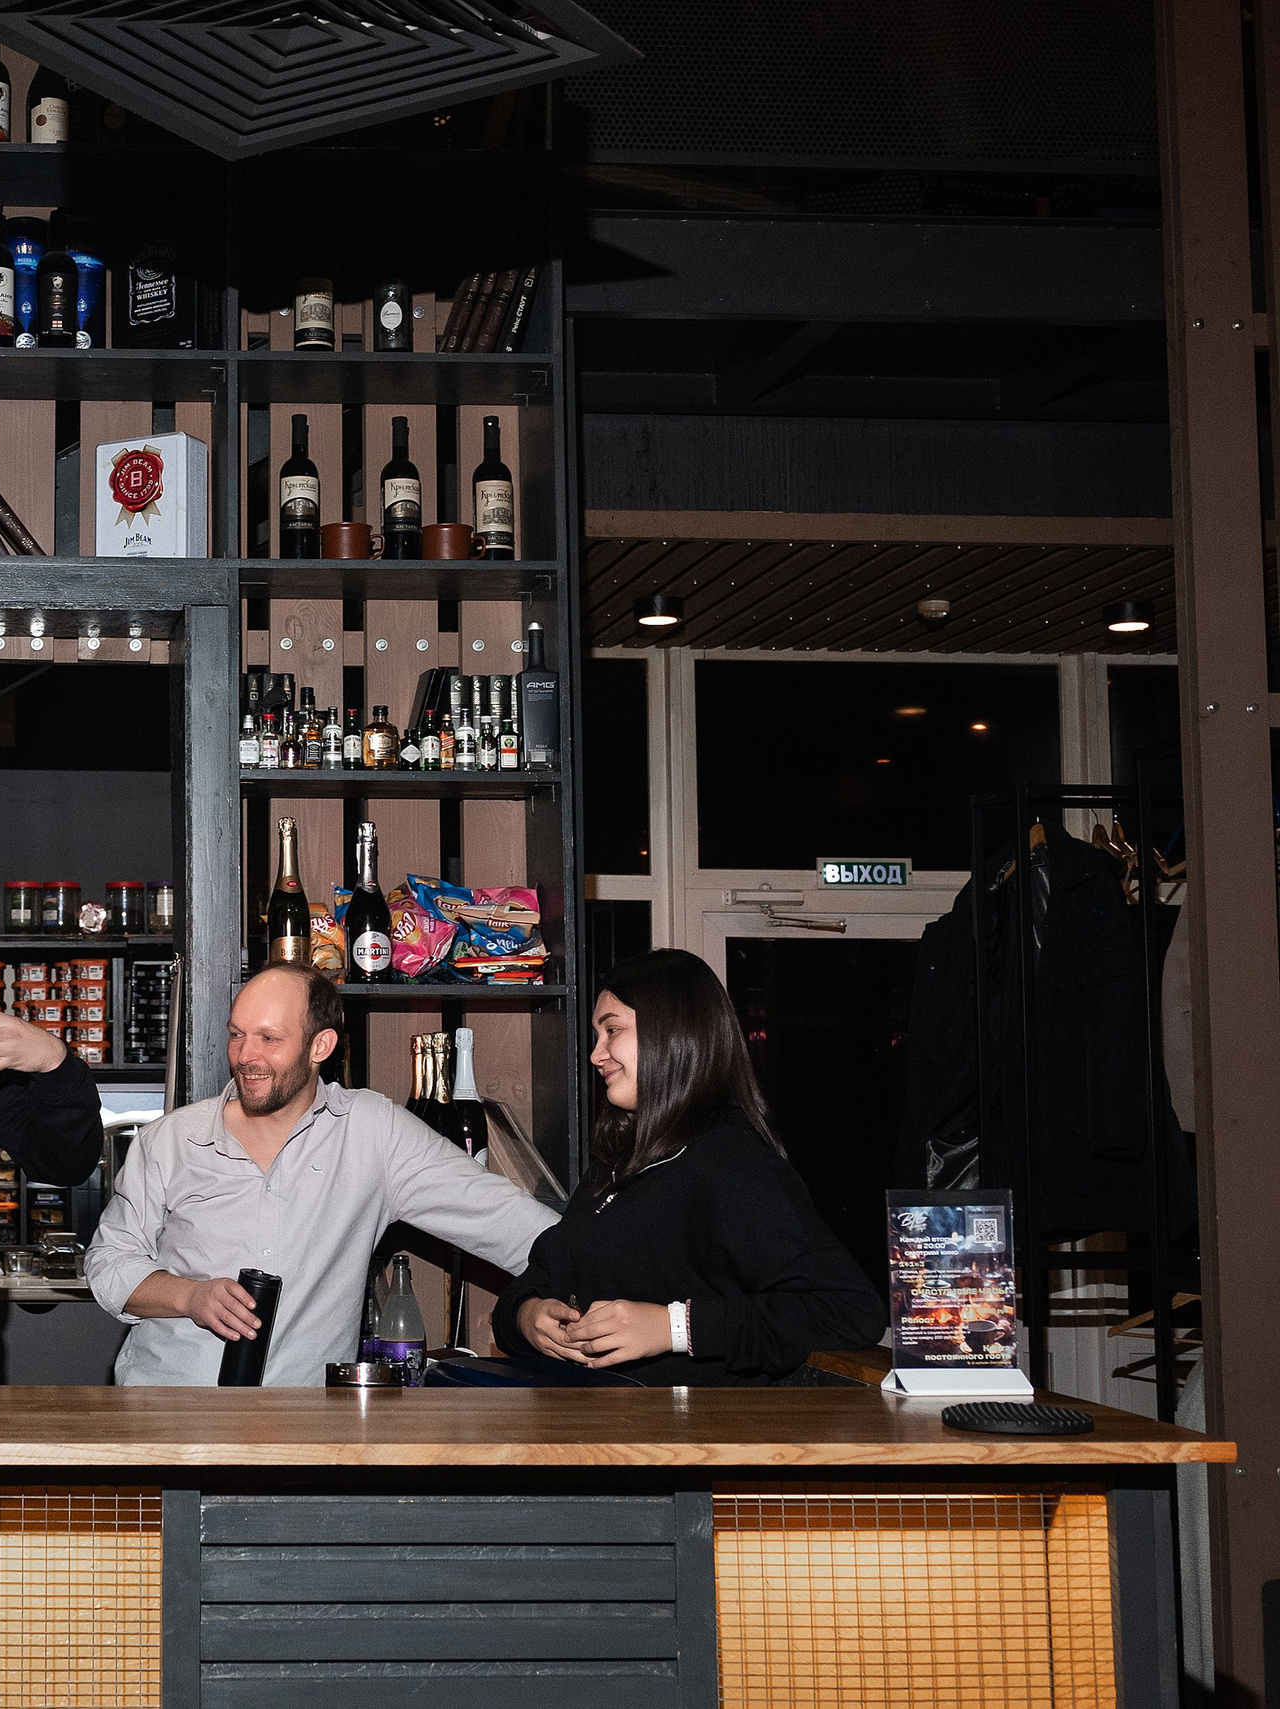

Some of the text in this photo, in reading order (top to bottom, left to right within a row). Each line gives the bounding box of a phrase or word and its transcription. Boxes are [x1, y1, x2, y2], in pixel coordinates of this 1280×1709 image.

[516, 295, 528, 317] СТАУТ
[120, 458, 153, 477] JIM BEAM
[130, 470, 143, 488] B
[119, 479, 154, 500] SINCE 1795
[123, 532, 152, 549] JIM BEAM
[526, 681, 555, 689] AMG
[824, 863, 903, 885] ВЫХОД
[357, 947, 389, 956] MARTINI
[899, 1236, 931, 1244] Каждый
[910, 1286, 1009, 1296] СЧАСТЛИВЫЕ ЧАСЫ
[901, 1316, 935, 1325] Репост
[924, 1353, 1011, 1362] постоянного гостя
